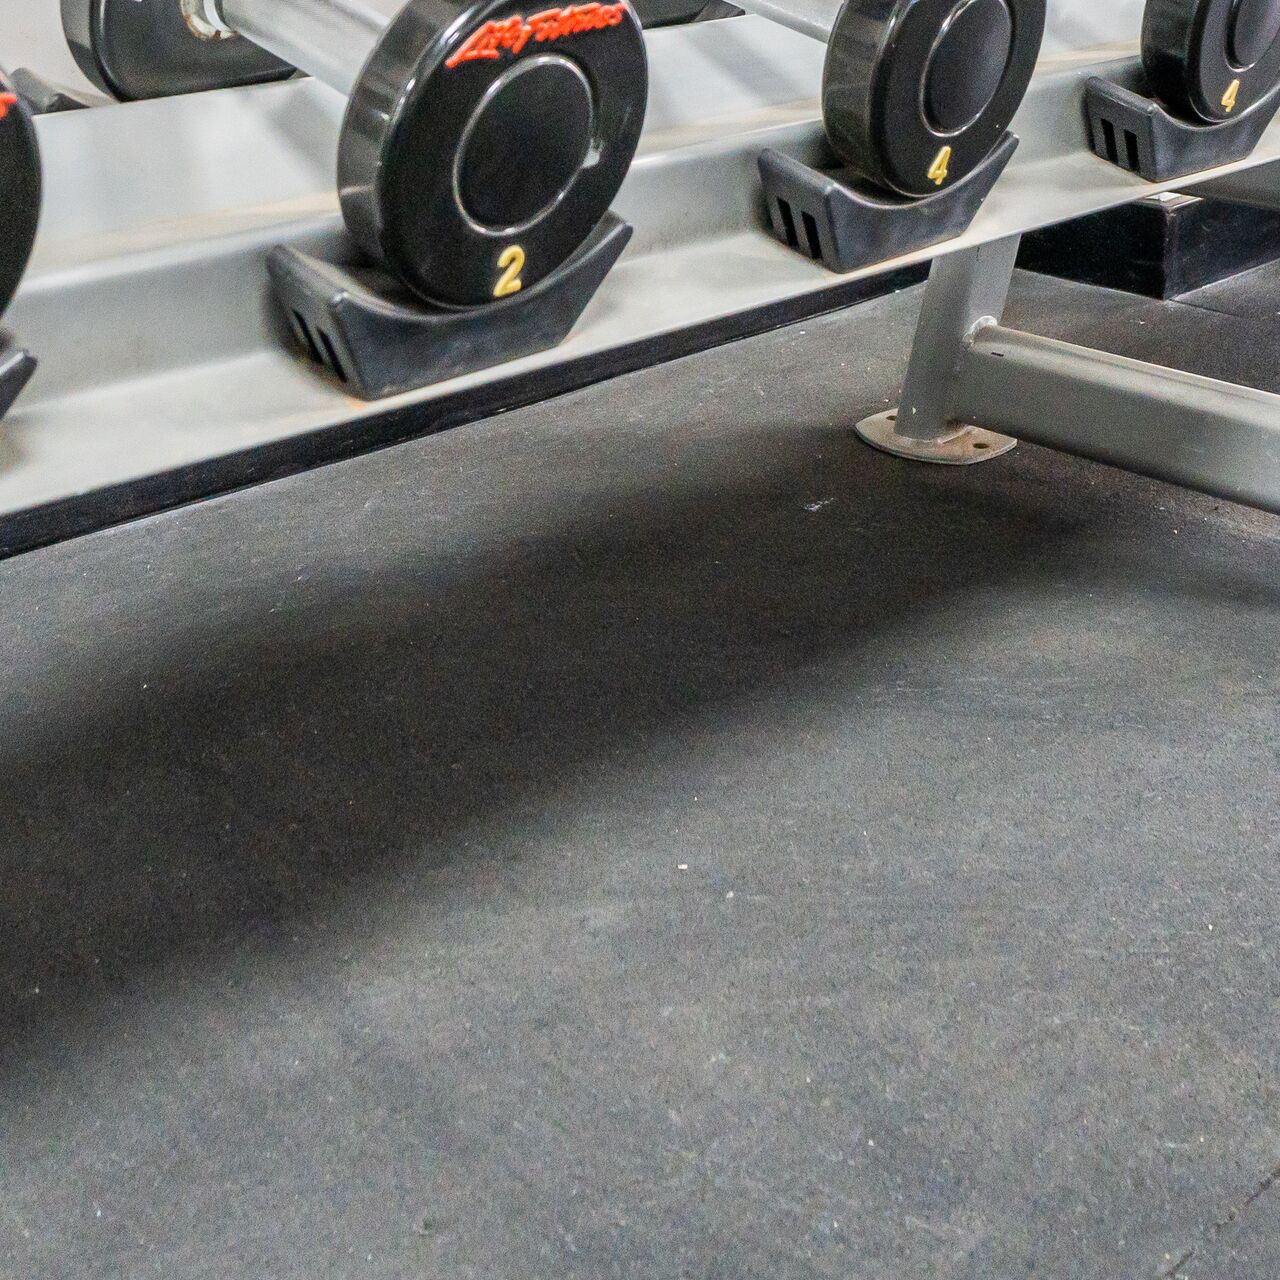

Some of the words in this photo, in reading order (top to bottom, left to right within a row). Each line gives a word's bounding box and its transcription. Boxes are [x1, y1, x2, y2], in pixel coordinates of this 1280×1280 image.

[1220, 78, 1242, 114] 4
[926, 145, 952, 186] 4
[492, 244, 527, 298] 2
